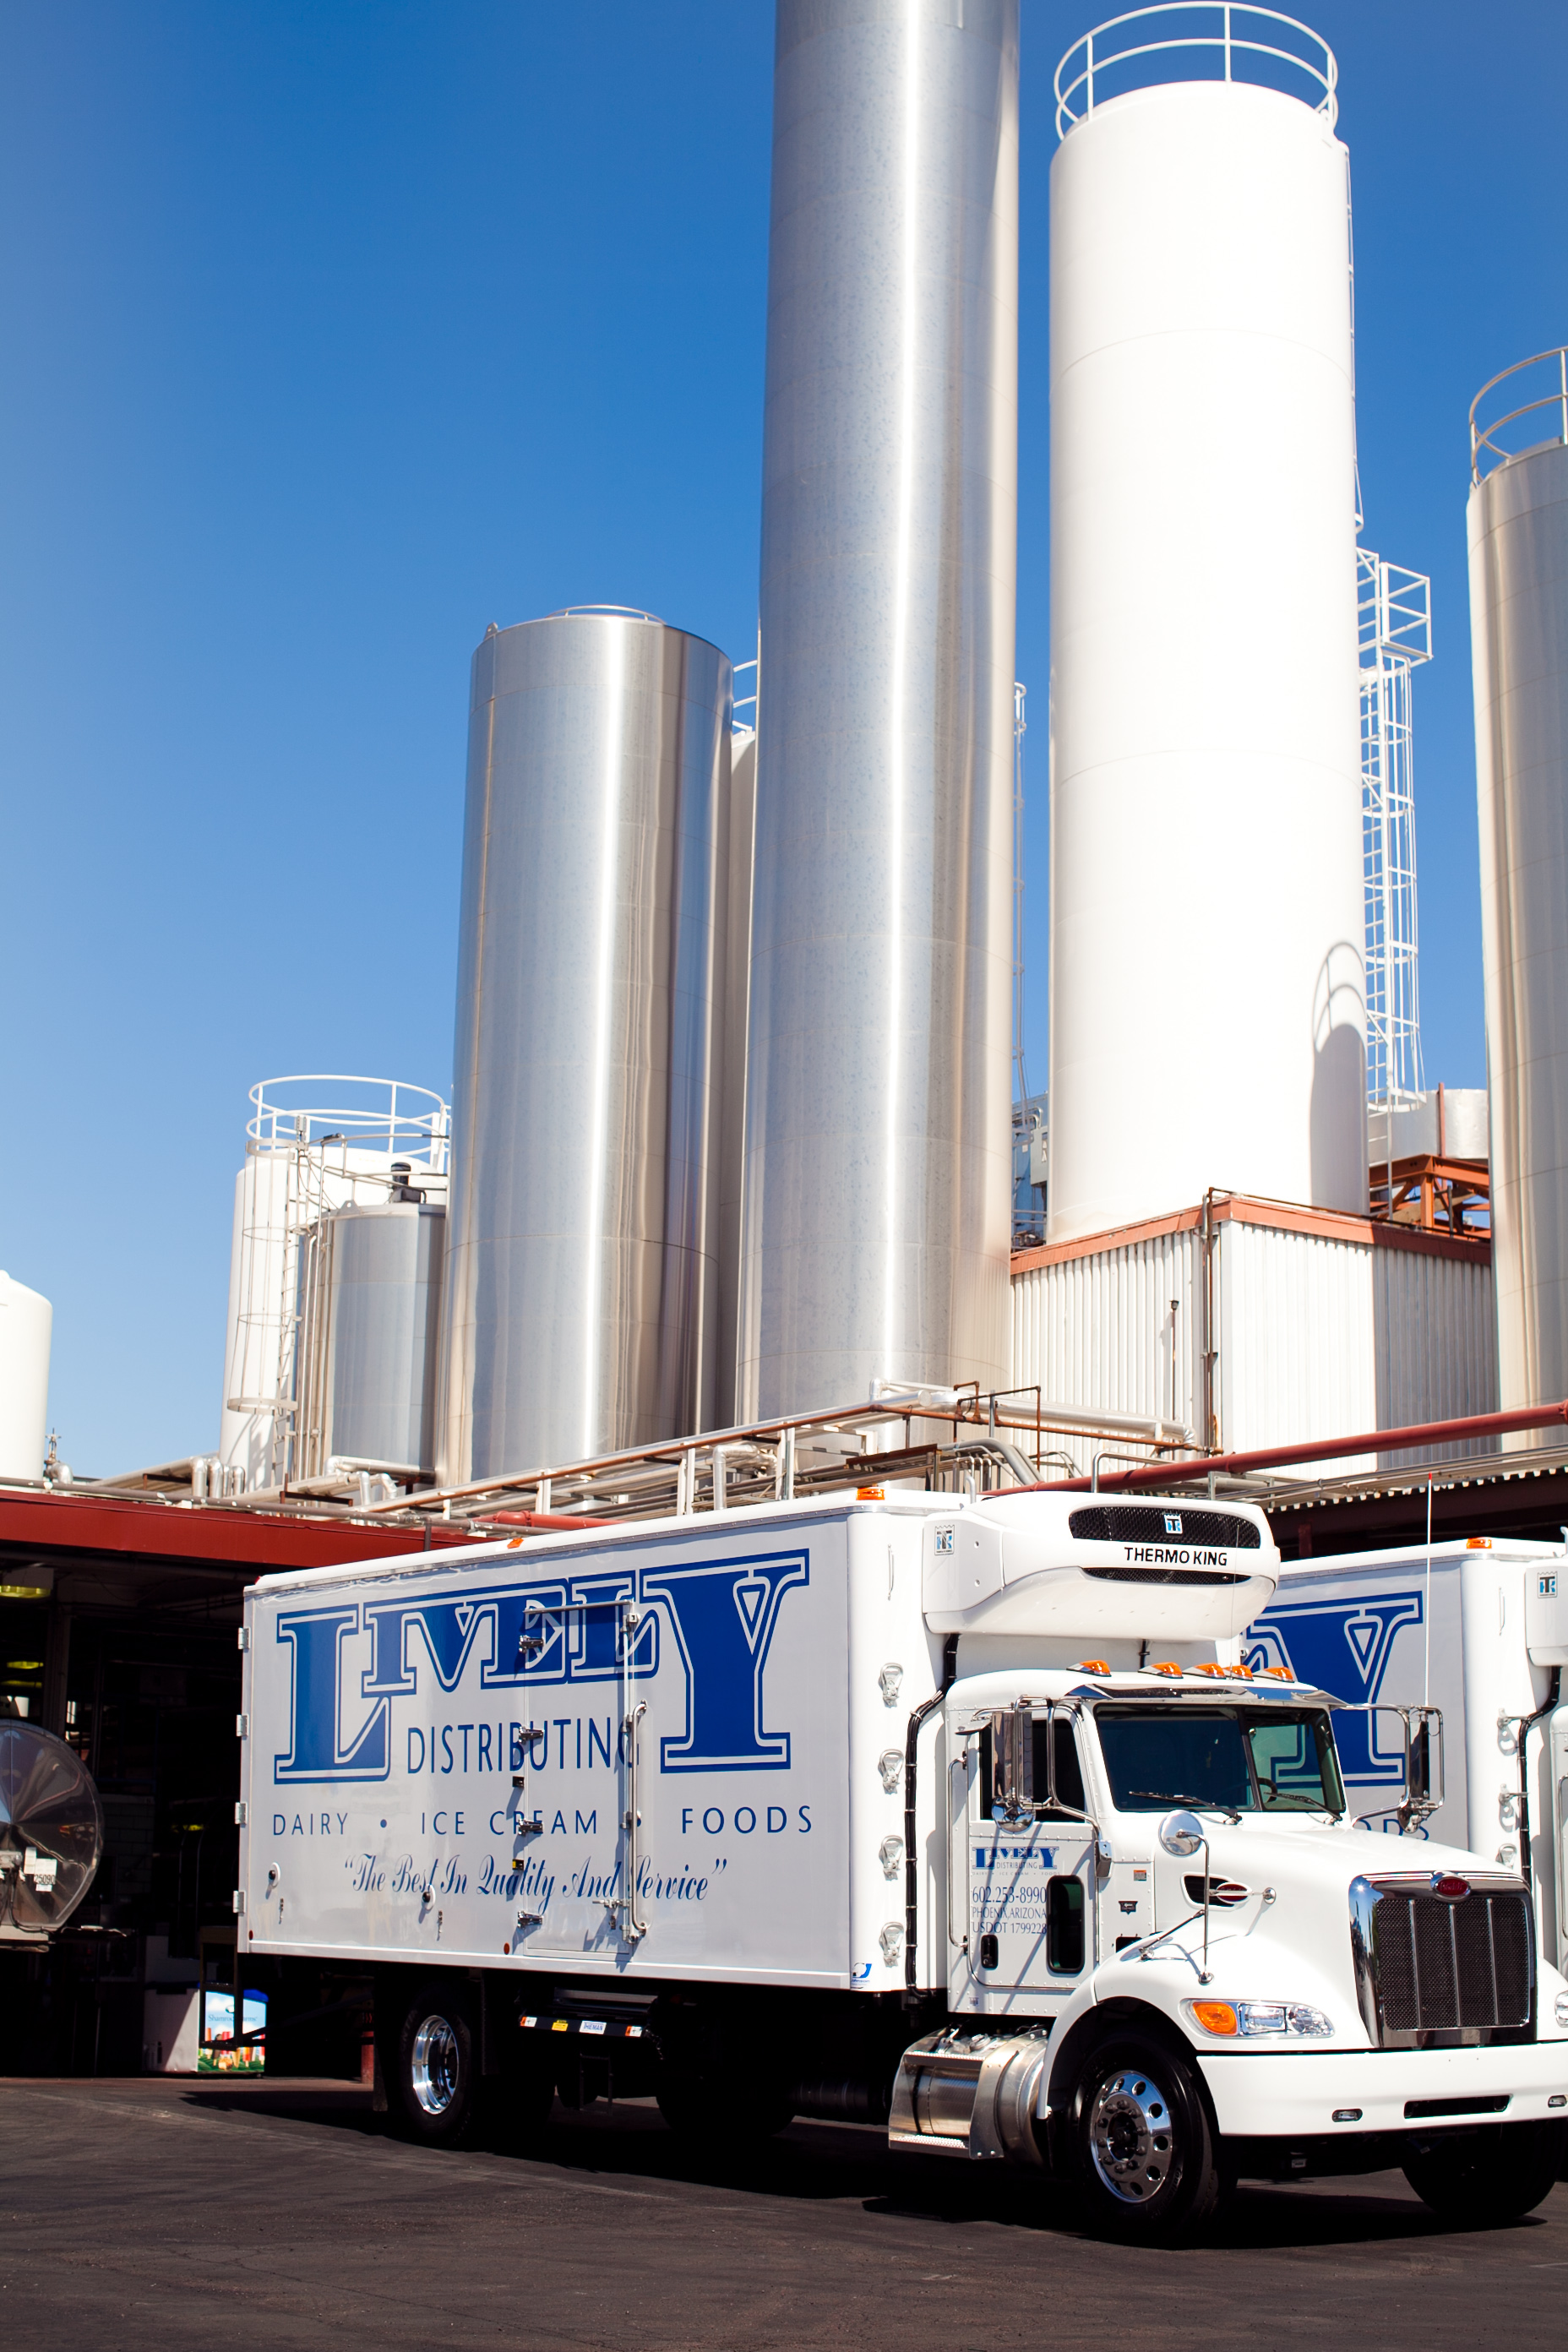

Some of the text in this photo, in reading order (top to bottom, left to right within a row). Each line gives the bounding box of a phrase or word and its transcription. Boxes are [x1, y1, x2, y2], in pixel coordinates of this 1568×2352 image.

[1124, 1546, 1228, 1566] THERMO KING
[275, 1549, 810, 1784] LIVELY
[273, 1812, 348, 1836] DAIRY
[422, 1810, 465, 1836] ICE
[683, 1805, 813, 1834] FOODS
[972, 1846, 1059, 1870] LIVELY
[997, 1861, 1037, 1870] DISTRIBUTING
[392, 1854, 439, 1894] Best
[441, 1854, 468, 1895] In
[476, 1854, 556, 1914] Quality
[562, 1856, 622, 1897] And
[972, 1886, 1048, 1903] 602.253-8990
[972, 1922, 1048, 1935] USDOT 1799228
